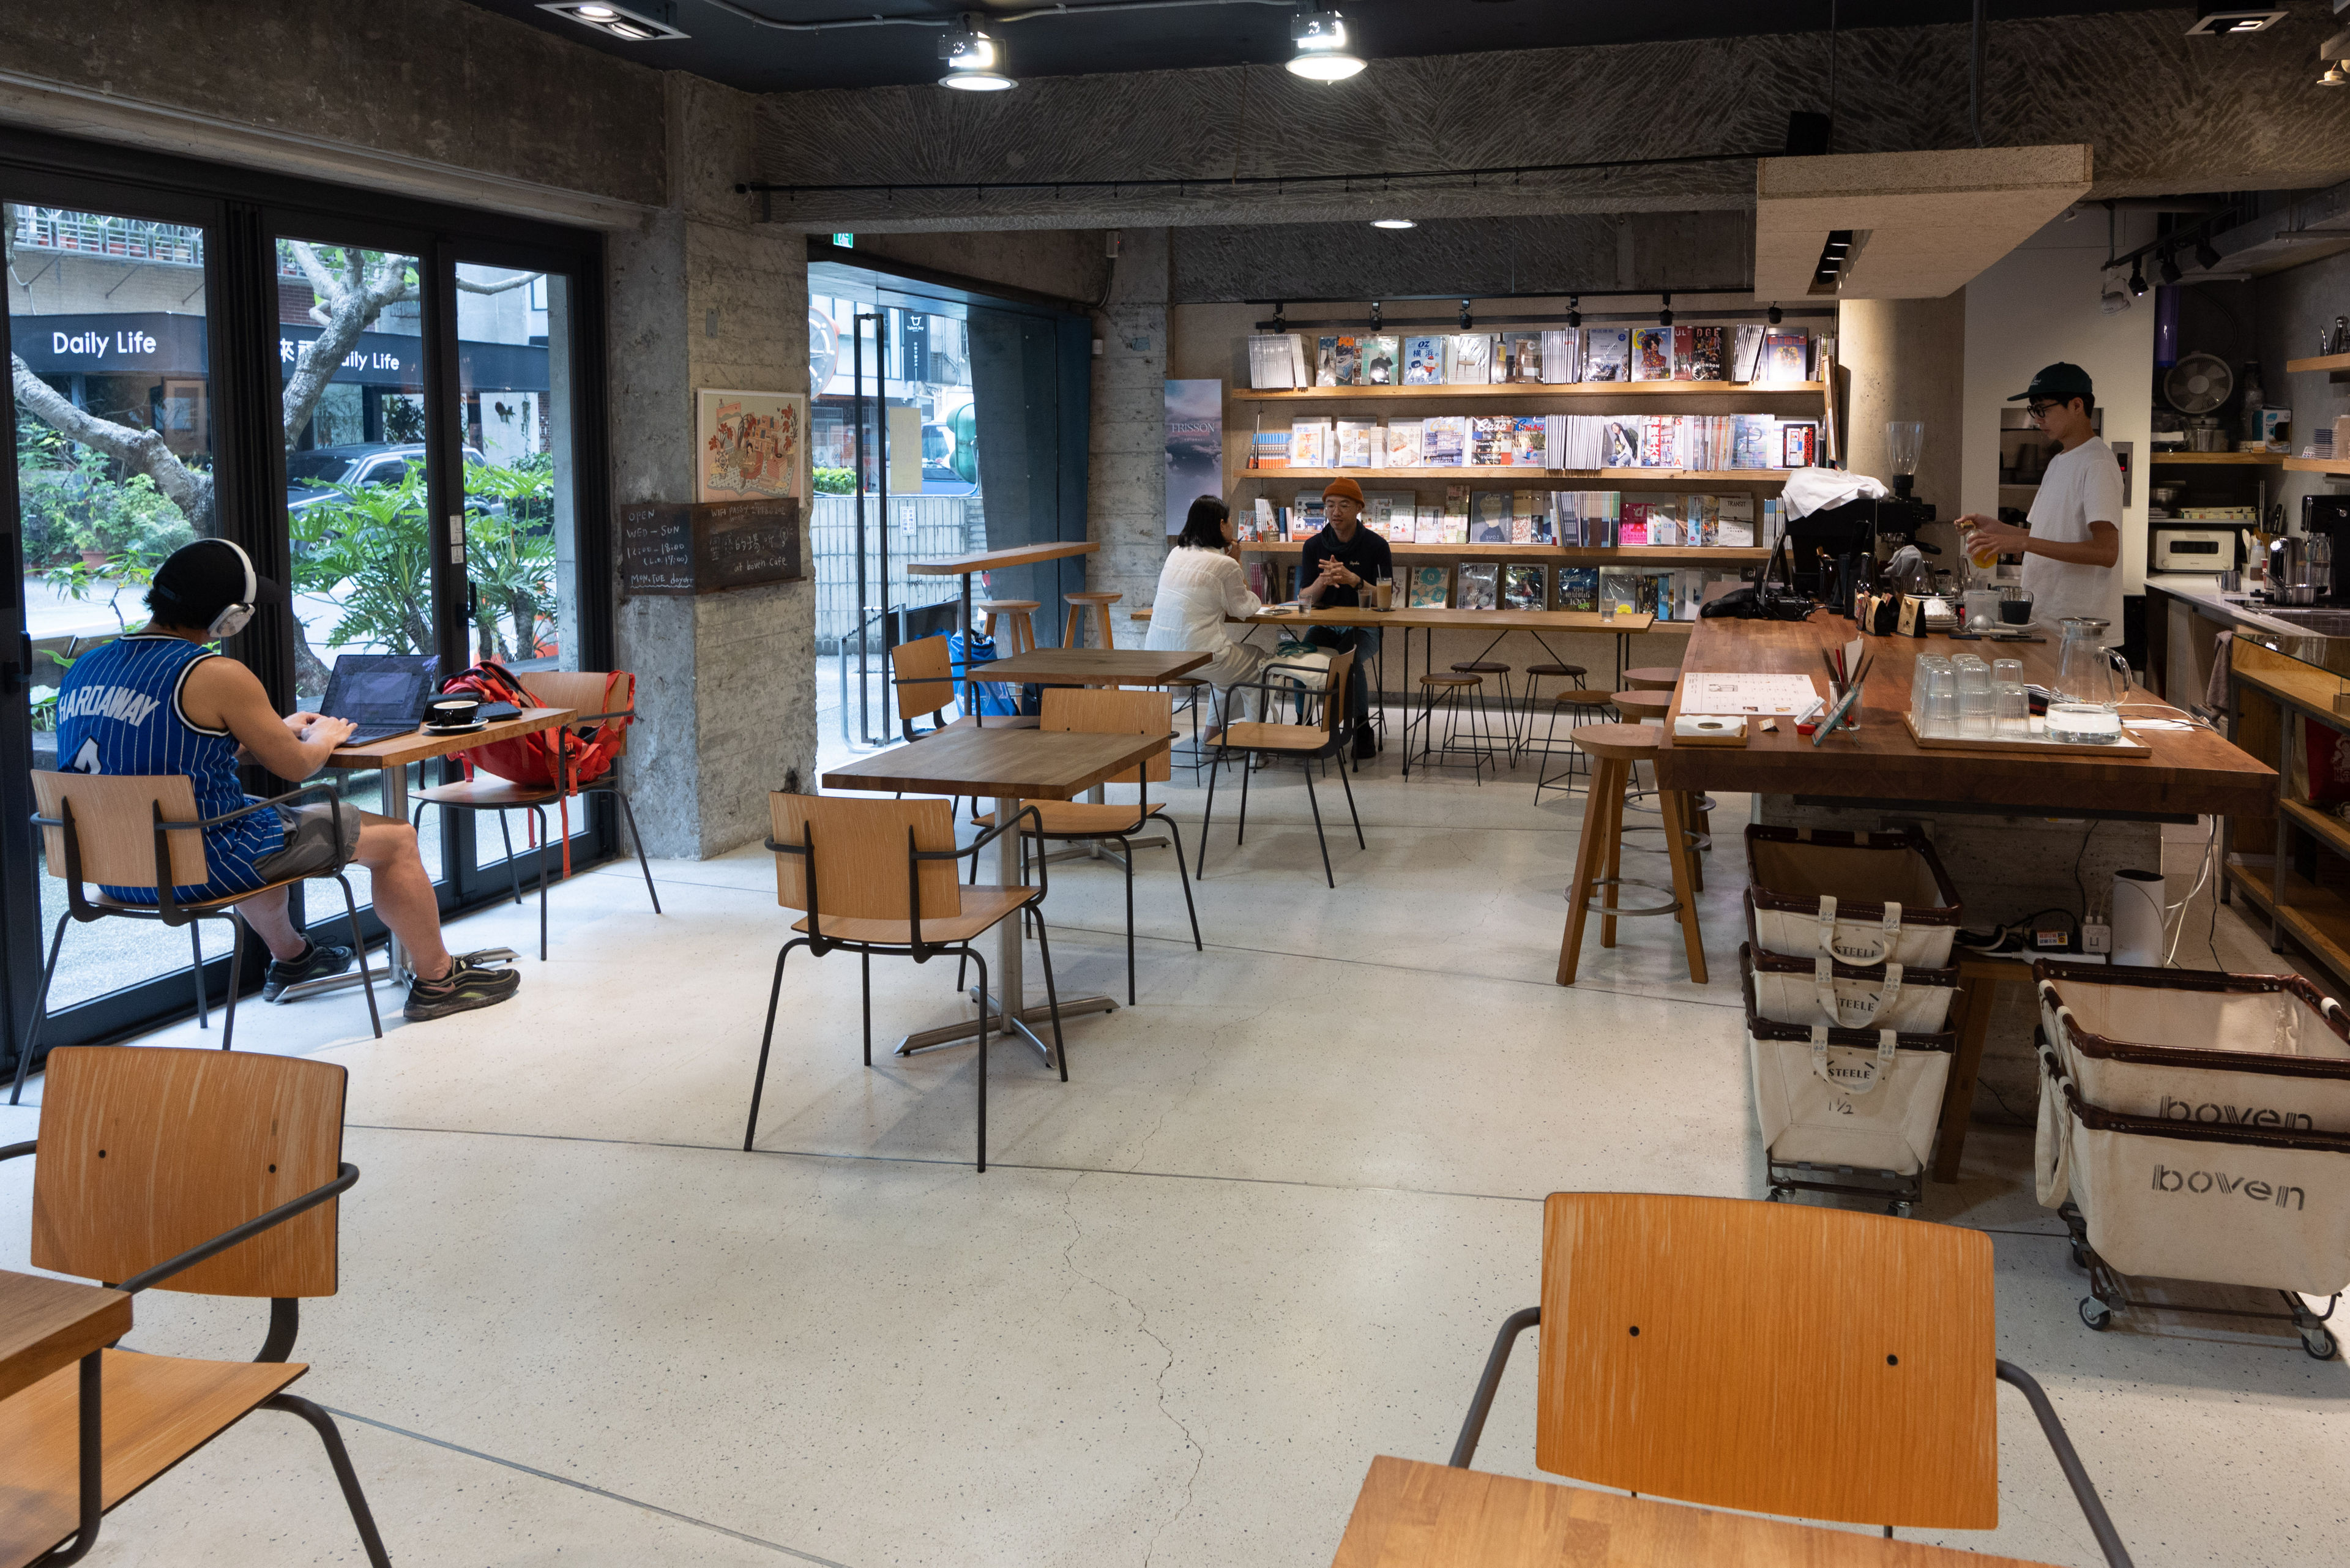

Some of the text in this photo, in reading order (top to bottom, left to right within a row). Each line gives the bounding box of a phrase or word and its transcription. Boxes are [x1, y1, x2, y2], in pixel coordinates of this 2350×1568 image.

[53, 330, 157, 359] Daily Life
[373, 353, 400, 370] Life
[1172, 423, 1215, 433] FRISSON
[629, 509, 655, 523] OPEN
[627, 528, 647, 538] WED
[661, 525, 679, 536] SUN
[747, 559, 766, 570] boven
[59, 685, 161, 727] HARDAWAY
[1836, 998, 1874, 1012] TEELE
[1828, 1068, 1871, 1079] STEELE
[2159, 1096, 2313, 1131] boven
[2152, 1164, 2305, 1211] boven
